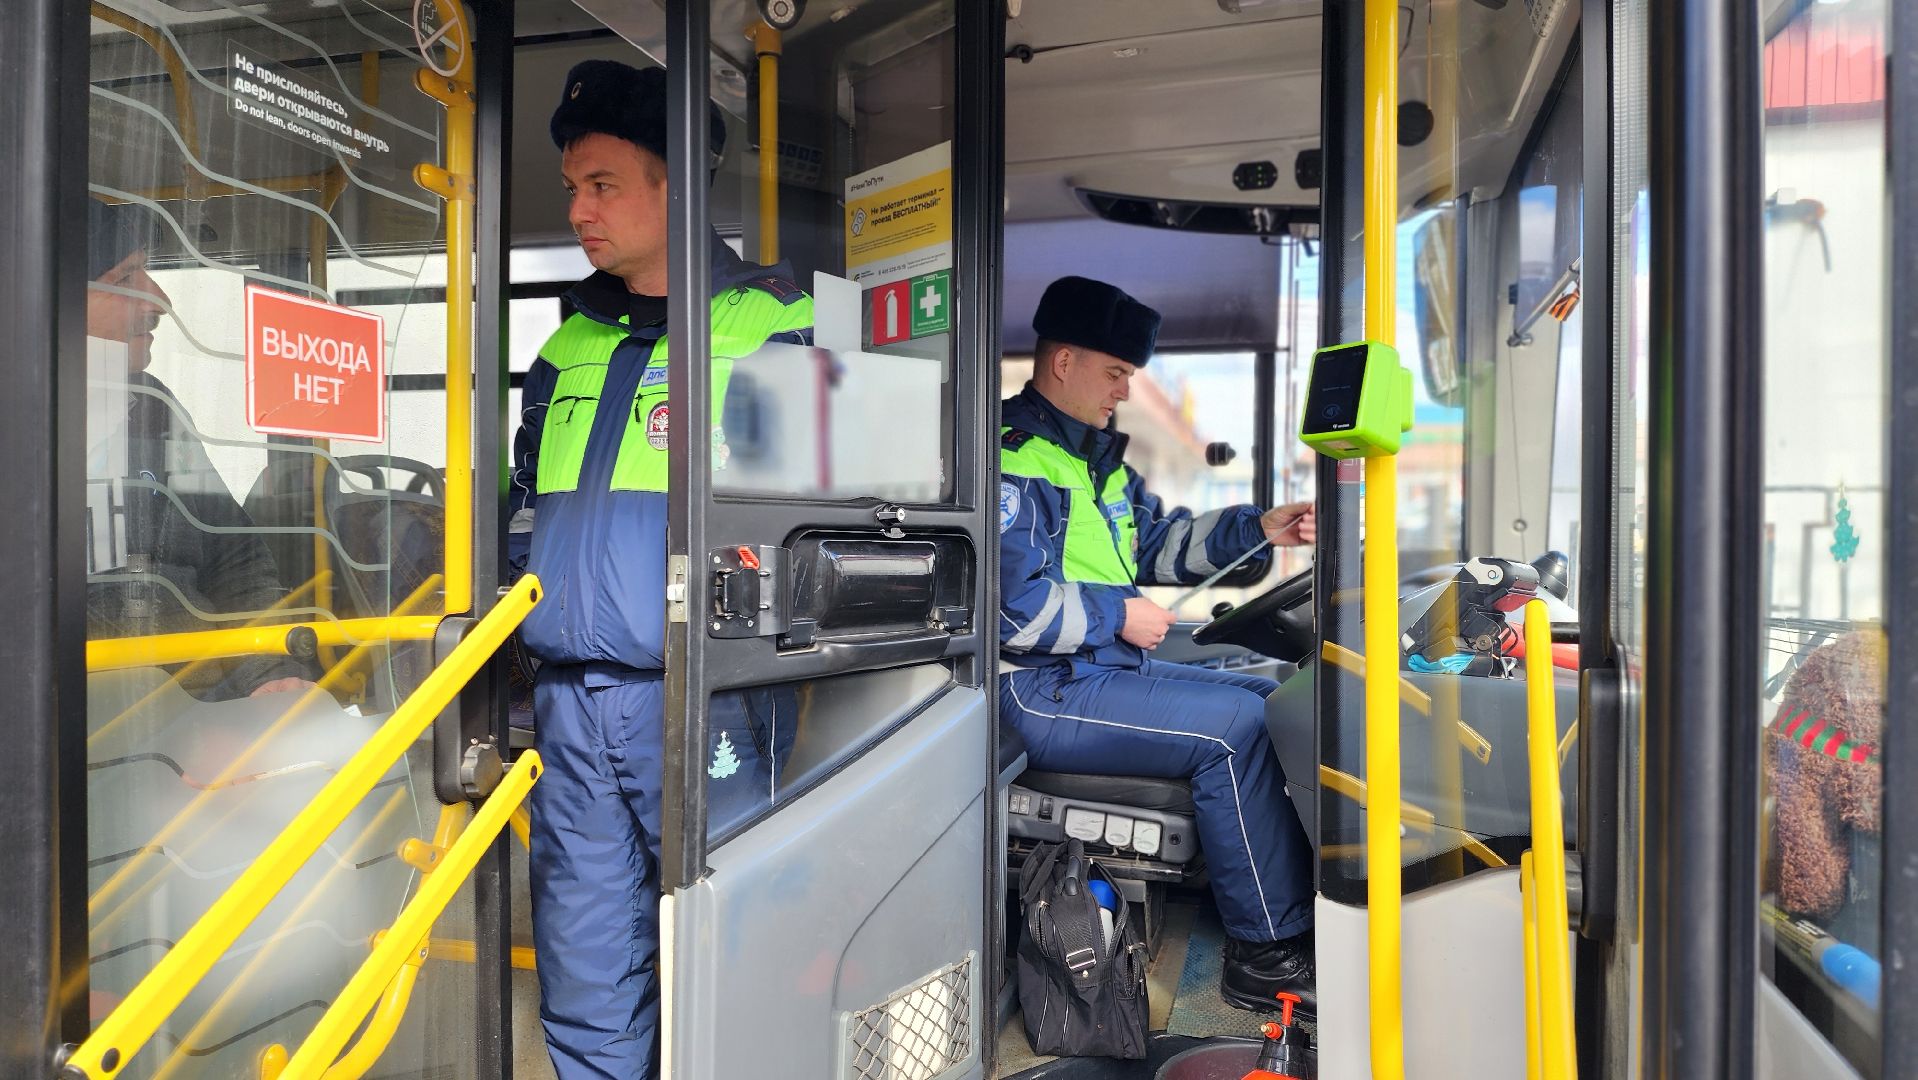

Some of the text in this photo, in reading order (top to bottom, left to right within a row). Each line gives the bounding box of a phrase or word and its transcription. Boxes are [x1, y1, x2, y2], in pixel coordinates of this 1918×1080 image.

[235, 52, 348, 118] Не прислоняйтесь,
[234, 77, 390, 153] двери открываются внутрь
[235, 98, 362, 159] Do not lean, doors open inwards
[870, 207, 879, 216] Не
[879, 199, 906, 214] работает
[907, 188, 937, 203] терминал
[870, 215, 892, 227] проезд
[262, 326, 372, 375] ВЫХОДА
[293, 372, 345, 405] НЕТ
[646, 370, 666, 381] ДПС
